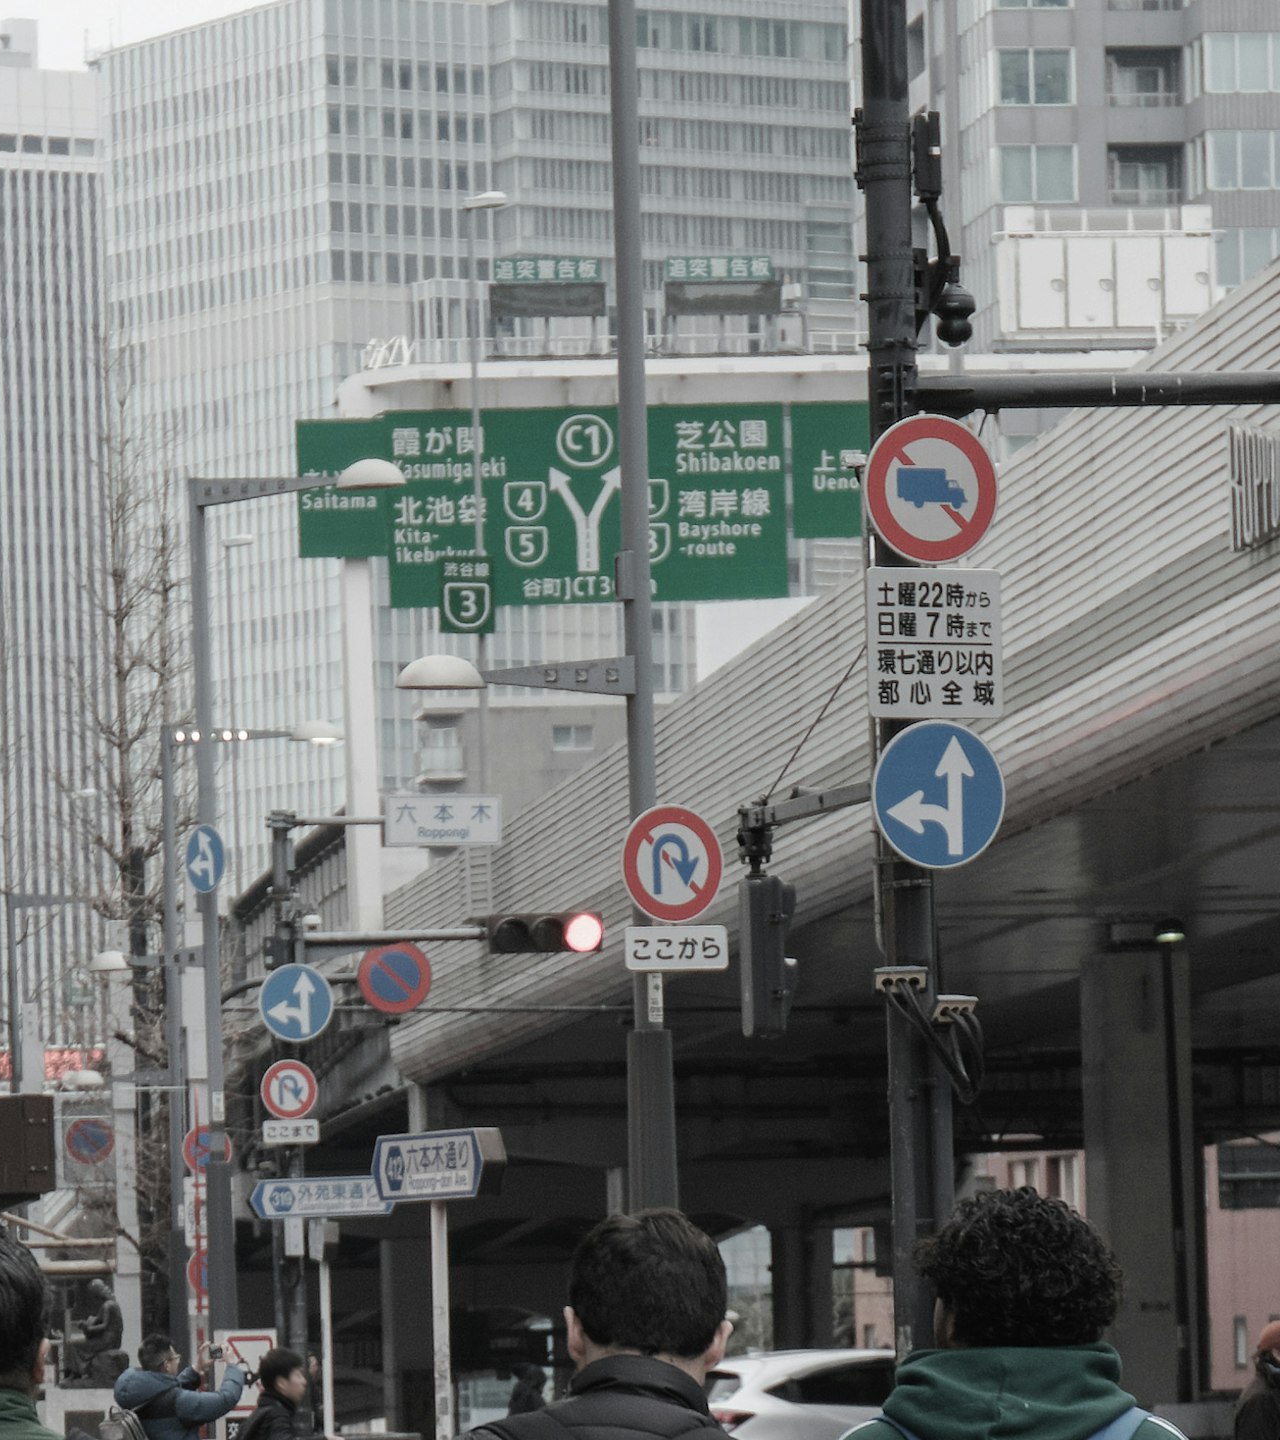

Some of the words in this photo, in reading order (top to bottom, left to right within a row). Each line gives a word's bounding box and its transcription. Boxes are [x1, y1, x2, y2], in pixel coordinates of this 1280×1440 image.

[494, 258, 598, 280] 追突警告板
[668, 256, 770, 279] 追突警告板
[565, 424, 600, 456] C1
[675, 419, 768, 450] 芝公園
[675, 451, 781, 474] Shibakoen
[813, 474, 858, 491] Ueno
[301, 494, 378, 510] Saitama
[517, 488, 534, 511] 4
[678, 488, 771, 518] 湾岸線
[393, 528, 440, 545] Kita-
[678, 521, 763, 540] Bayshore
[518, 534, 535, 557] 5
[678, 541, 737, 557] -route
[444, 562, 491, 578] 渋谷線
[459, 590, 478, 617] 3
[877, 581, 991, 608] 土曜22時から
[877, 649, 993, 676] 環七通り以内
[877, 679, 995, 706] 都心全域
[395, 803, 492, 826] 六本木
[416, 824, 471, 842] Roppongi
[633, 936, 722, 961] ここから
[267, 1124, 315, 1138] ここまで
[405, 1141, 469, 1173] 六本木通り
